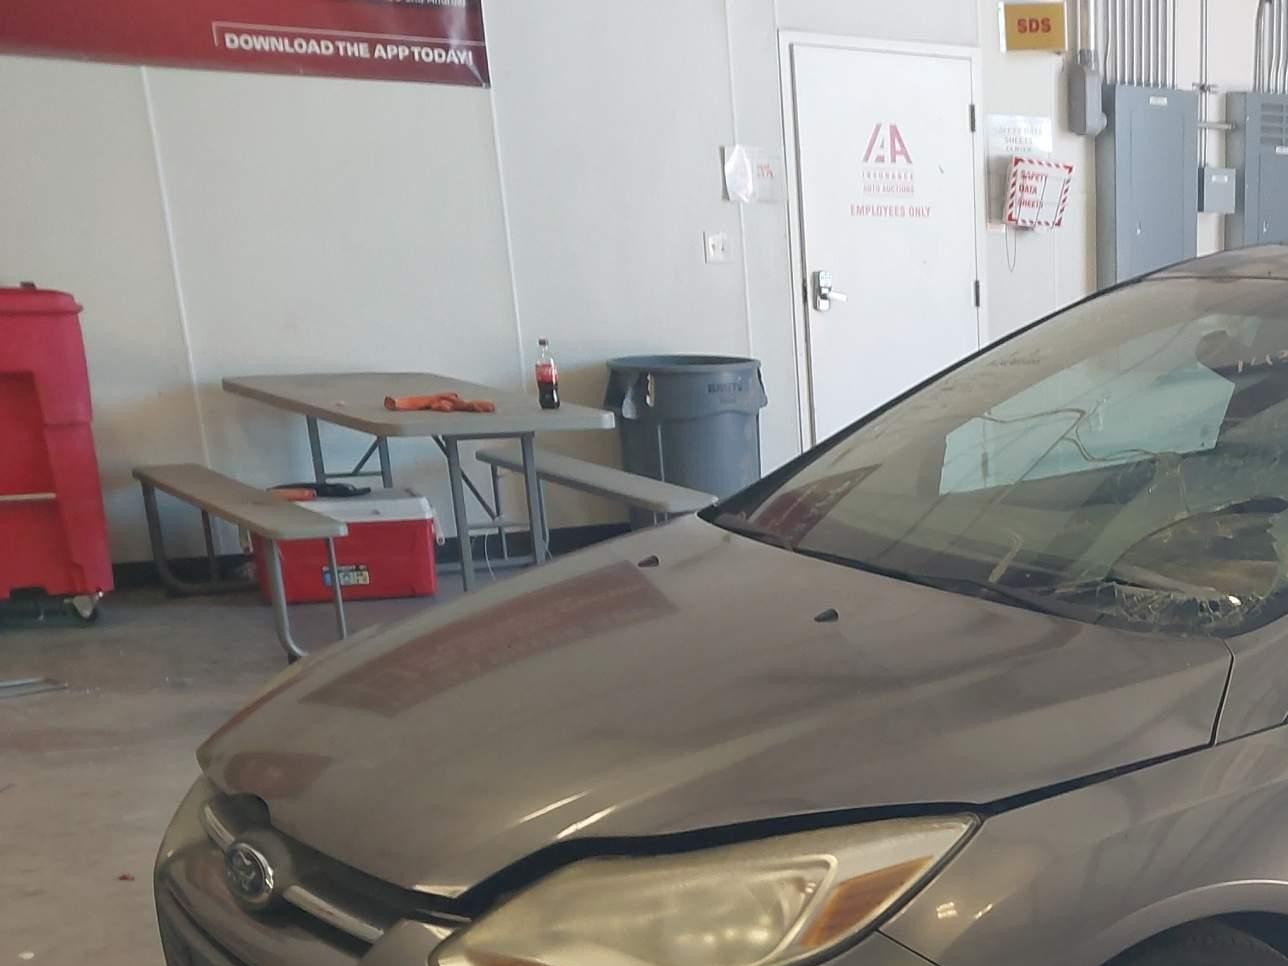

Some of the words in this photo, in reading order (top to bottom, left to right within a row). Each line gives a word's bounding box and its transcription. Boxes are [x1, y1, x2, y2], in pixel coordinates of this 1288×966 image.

[1017, 17, 1051, 33] SDS
[225, 33, 333, 54] DOWNLOAD
[336, 42, 370, 58] THE
[373, 44, 409, 61] APP
[411, 47, 473, 65] TODAY!
[1018, 184, 1038, 194] DATA
[850, 203, 906, 217] EMPLOYEES
[908, 205, 931, 218] ONLY
